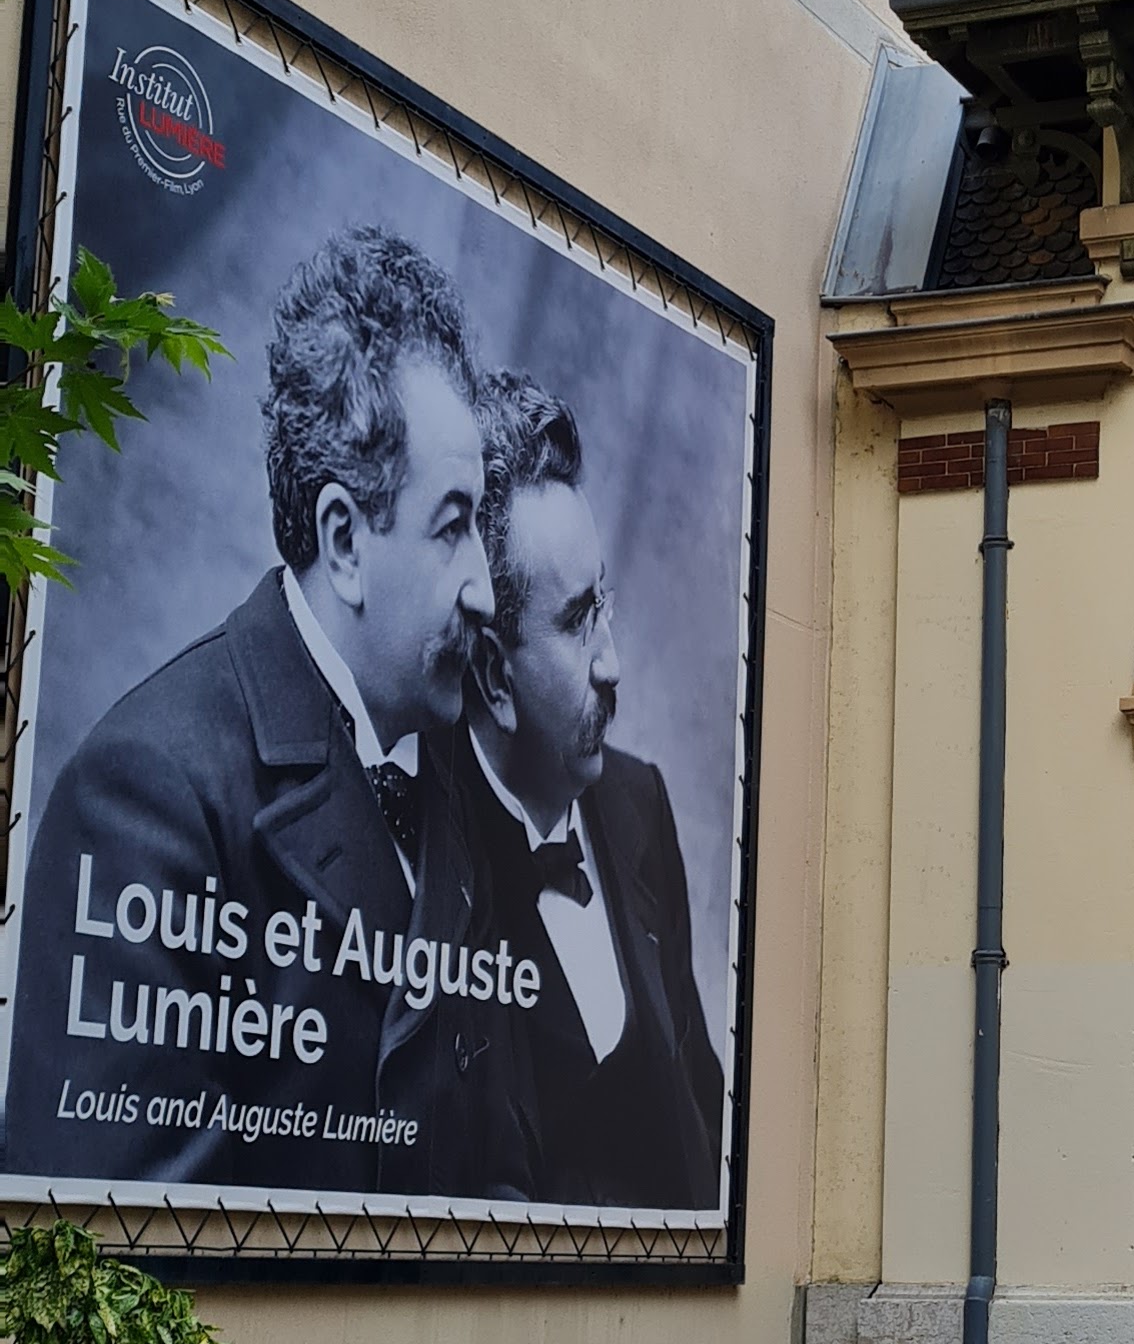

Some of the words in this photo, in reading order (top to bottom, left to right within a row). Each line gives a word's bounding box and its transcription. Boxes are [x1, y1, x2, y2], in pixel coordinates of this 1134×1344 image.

[108, 47, 193, 121] Institut
[115, 97, 127, 124] Rue
[121, 125, 133, 144] du
[183, 179, 204, 196] Lyon
[74, 853, 249, 960] Louis
[264, 900, 322, 973] et
[332, 907, 541, 1010] Auguste
[66, 954, 328, 1065] Lumière
[56, 1079, 140, 1124] Louis
[146, 1091, 207, 1129] and
[207, 1094, 318, 1143] Auguste
[322, 1104, 419, 1146] Lumière
